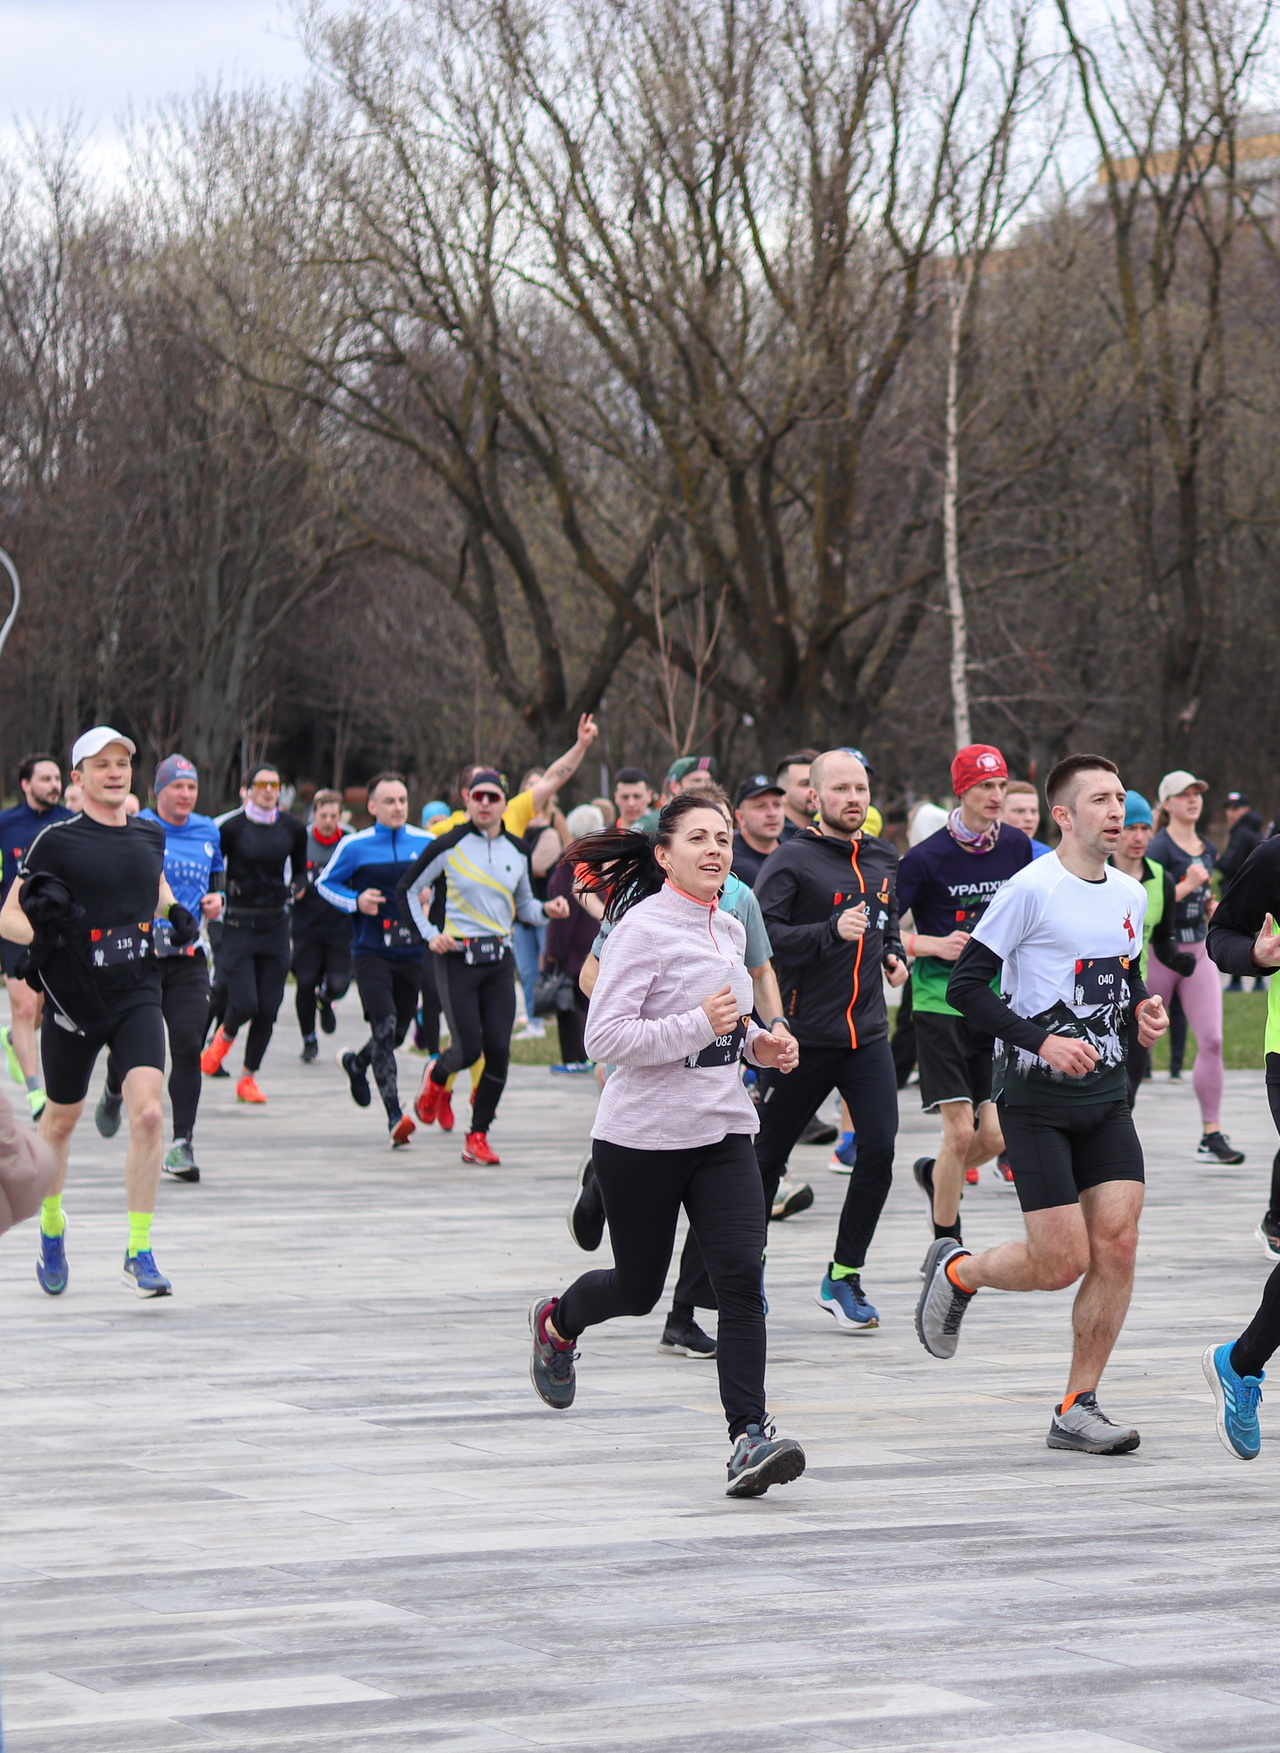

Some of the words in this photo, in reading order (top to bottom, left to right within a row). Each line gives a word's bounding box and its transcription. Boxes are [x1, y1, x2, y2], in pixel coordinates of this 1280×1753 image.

[948, 879, 1008, 896] УРАЛХ
[117, 937, 133, 950] 135
[1098, 973, 1114, 986] 040
[715, 1035, 733, 1047] 082
